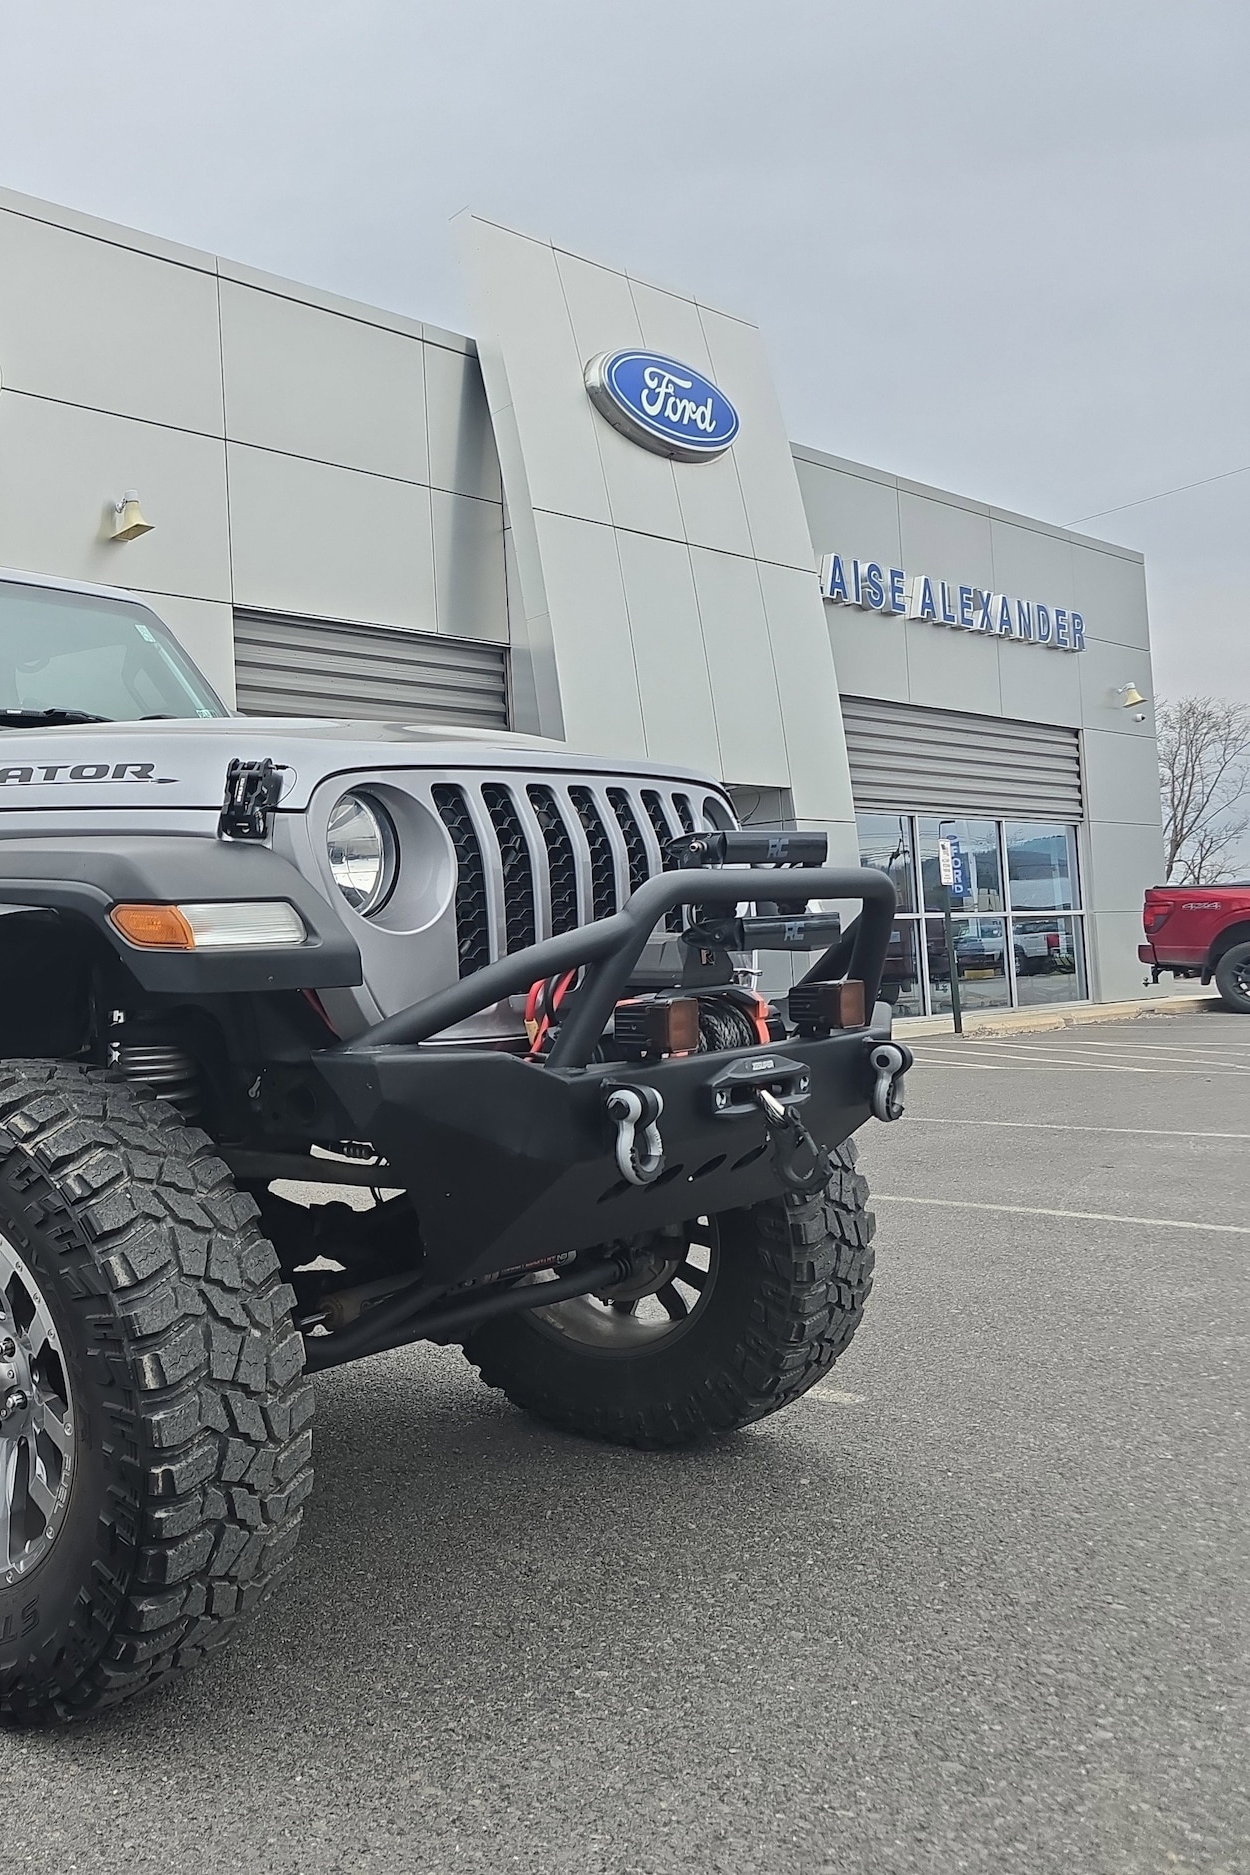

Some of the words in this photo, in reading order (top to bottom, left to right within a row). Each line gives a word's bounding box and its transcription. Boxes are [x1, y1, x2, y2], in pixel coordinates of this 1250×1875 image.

[641, 367, 716, 433] Ford
[820, 552, 907, 615] AISE
[916, 575, 1086, 651] ALEXANDER
[767, 838, 789, 858] RC
[783, 921, 805, 941] RC
[53, 1452, 72, 1515] FUEL
